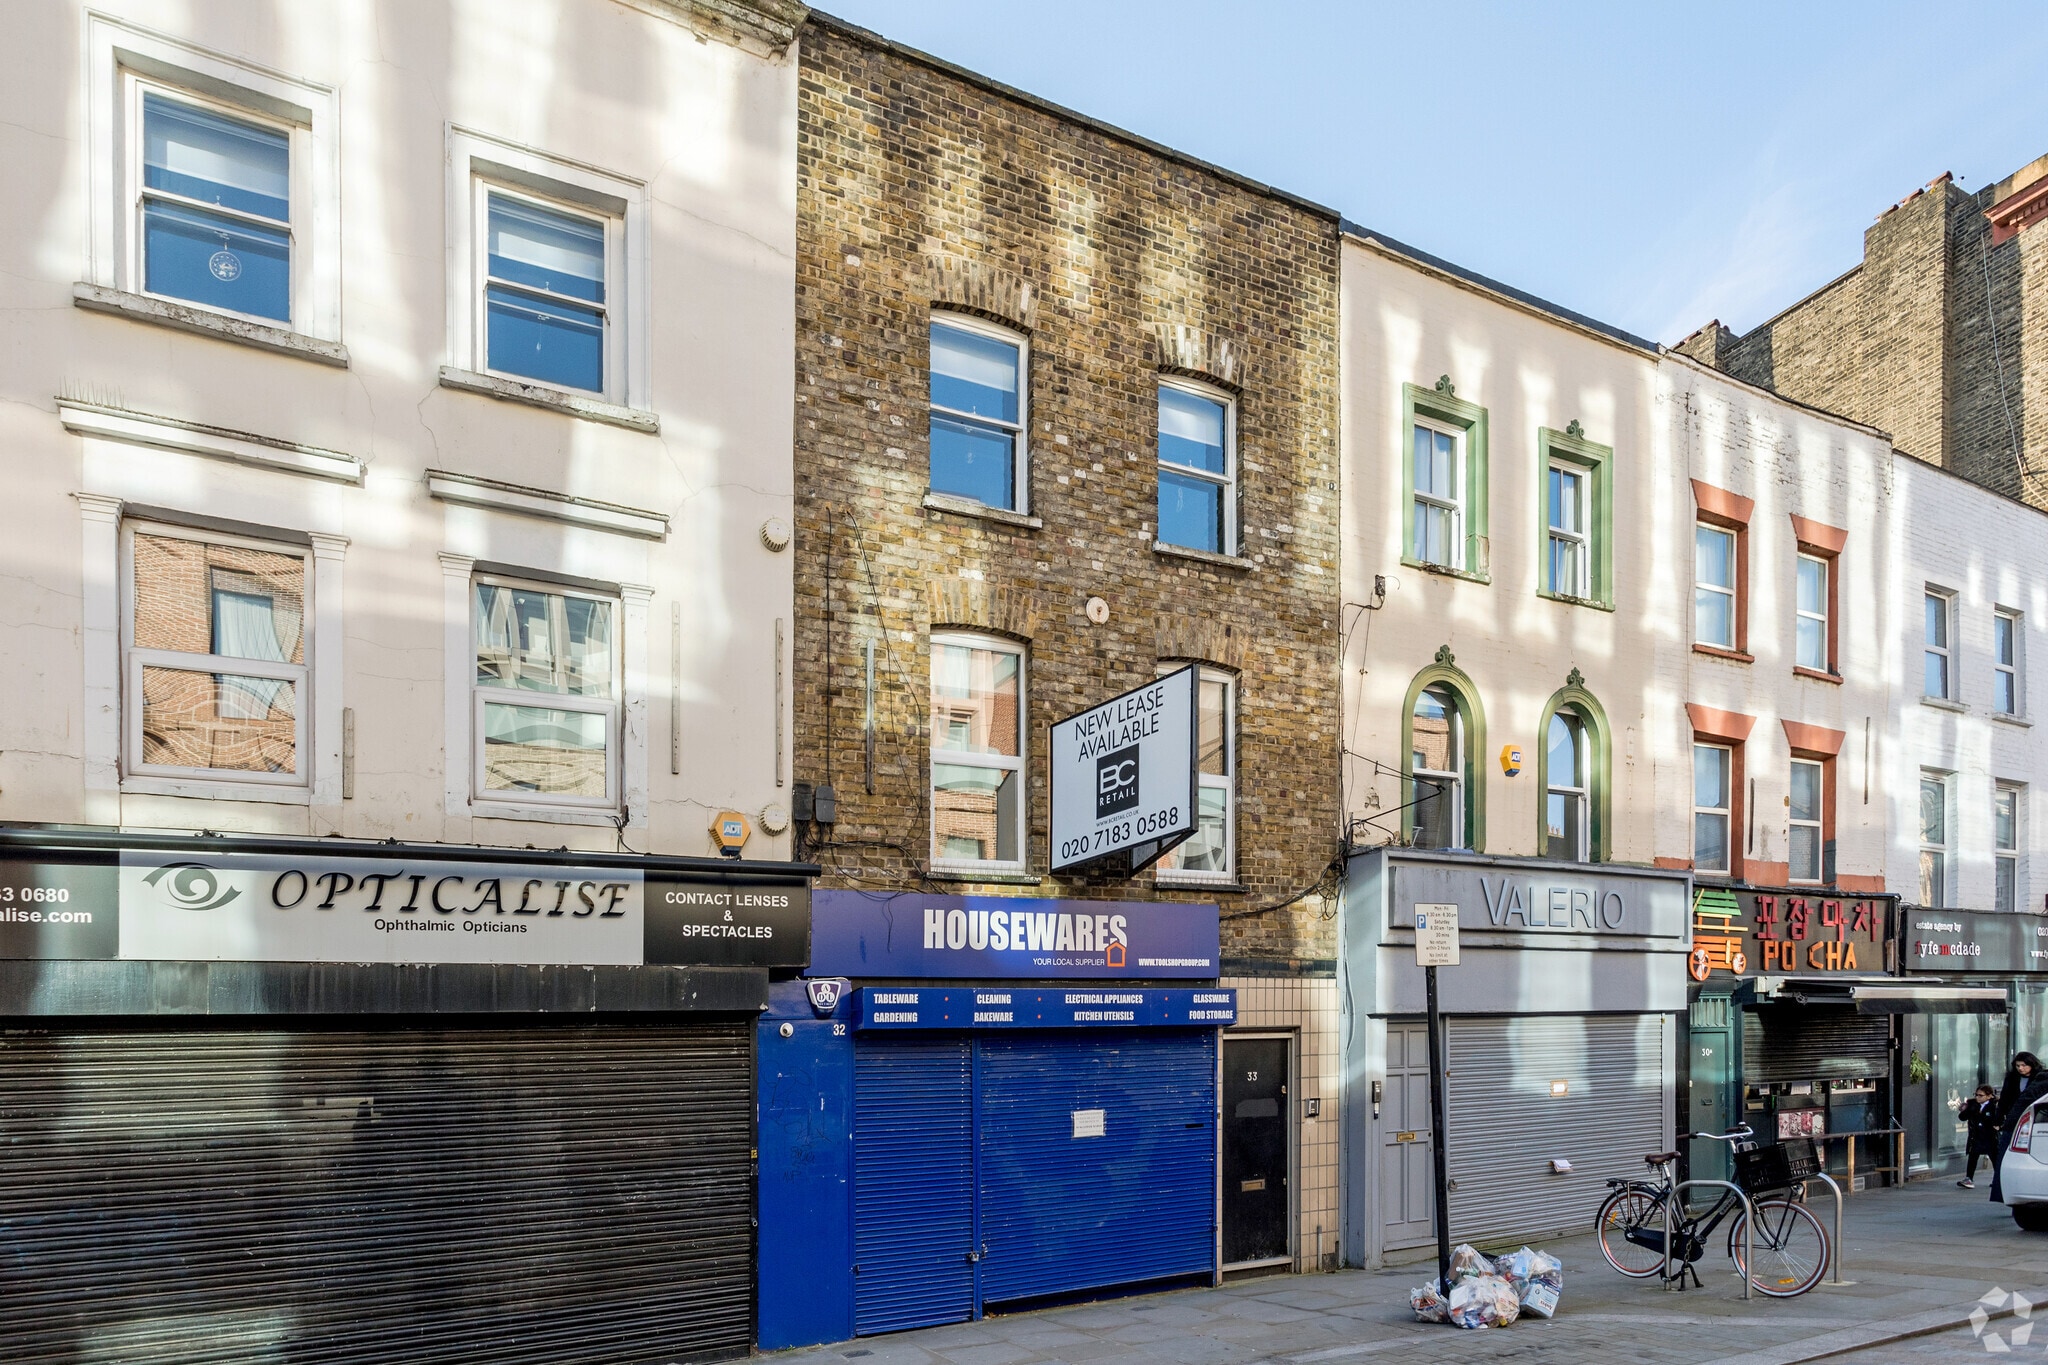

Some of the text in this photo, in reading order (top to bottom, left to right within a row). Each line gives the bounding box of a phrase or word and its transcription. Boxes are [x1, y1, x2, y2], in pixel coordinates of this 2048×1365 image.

[1075, 686, 1164, 740] NEW LEASE
[1078, 712, 1160, 762] AVAILABLE
[1100, 759, 1136, 794] BC
[1100, 786, 1136, 806] RETAIL
[724, 824, 742, 834] ADT
[1062, 807, 1178, 859] 020 7183 0588
[0, 887, 69, 903] 3 0680
[270, 869, 631, 918] OPTICALISE
[665, 891, 789, 907] CONTACT LENSES
[1481, 877, 1626, 929] VALERIO
[723, 909, 733, 922] &
[1756, 896, 1882, 942] 포장마차
[374, 918, 527, 935] Ophthalmic Opticians
[682, 924, 773, 938] SPECTACLES
[923, 909, 1128, 951] HOUSEWARES
[1915, 922, 1962, 933] estate agency by
[1033, 958, 1105, 966] YOUR LOCAL SUPPLIER
[1763, 940, 1857, 971] PO CHA
[873, 993, 919, 1004] TABLEWARE
[976, 994, 1012, 1005] CLEANING
[1065, 994, 1143, 1004] ELECTRICAL APPLIANCES
[1193, 994, 1230, 1004] GLASSWARE
[873, 1012, 918, 1023] GARDENING
[973, 1012, 1014, 1022] BAKEWARE
[1074, 1011, 1134, 1021] KITCHEN UTENSILS
[1189, 1010, 1234, 1020] FOOD STORAGE
[833, 1023, 846, 1036] 32
[1247, 1071, 1258, 1081] 33
